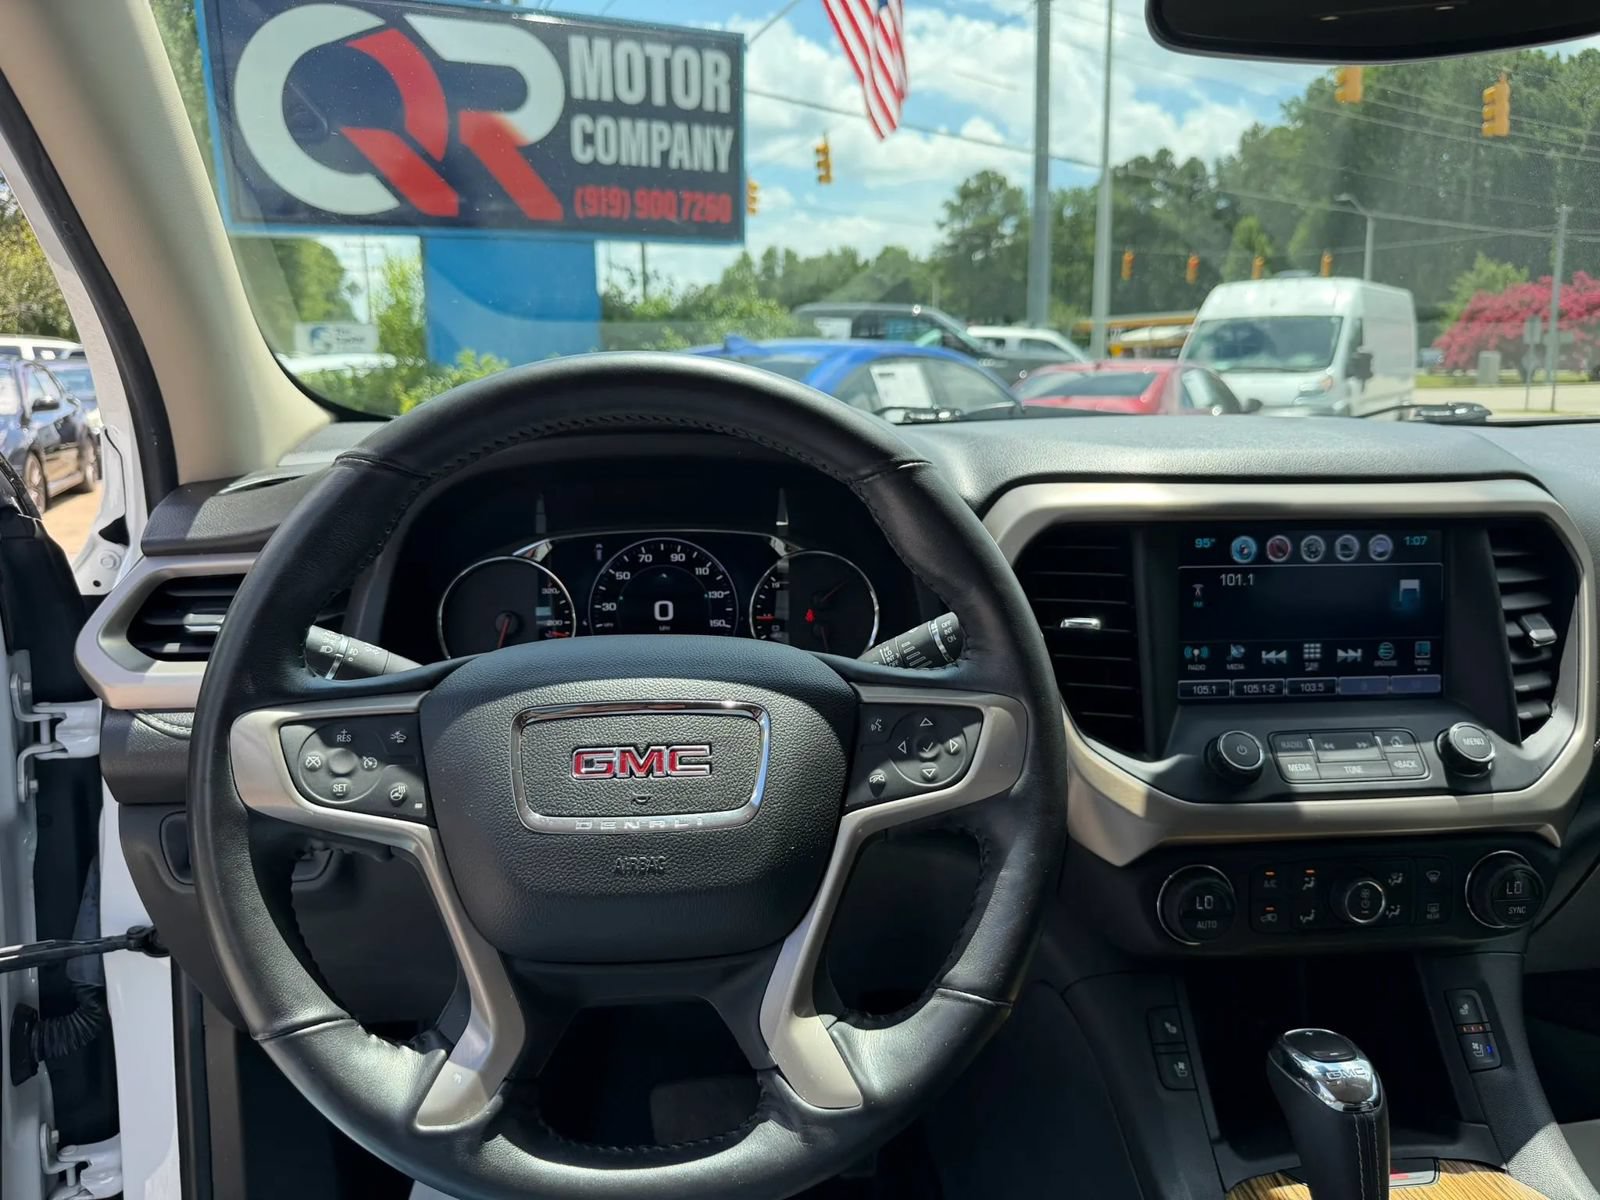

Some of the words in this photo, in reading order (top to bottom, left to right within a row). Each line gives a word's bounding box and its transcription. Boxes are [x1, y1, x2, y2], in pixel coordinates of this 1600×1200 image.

[568, 35, 731, 114] MOTOR
[570, 113, 734, 173] COMPANY
[1404, 535, 1428, 546] 1:07
[638, 553, 653, 563] 70
[670, 553, 686, 563] 90
[615, 571, 631, 581] 50
[695, 567, 710, 576] 110
[1219, 573, 1255, 587] 101.1
[708, 590, 725, 599] 130
[601, 602, 617, 611] 30
[653, 600, 674, 621] 0
[709, 619, 726, 628] 150
[1192, 685, 1217, 695] 105.1
[336, 734, 352, 743] RES
[1462, 736, 1485, 747] MENU
[571, 744, 712, 780] GMC
[1287, 762, 1313, 773] MEDIA
[332, 783, 348, 792] SET
[575, 817, 703, 830] DENALI
[615, 855, 667, 875] AIRBAG
[1507, 906, 1527, 915] SYNC
[1196, 920, 1218, 929] AUTO
[1325, 1067, 1367, 1080] GMC
